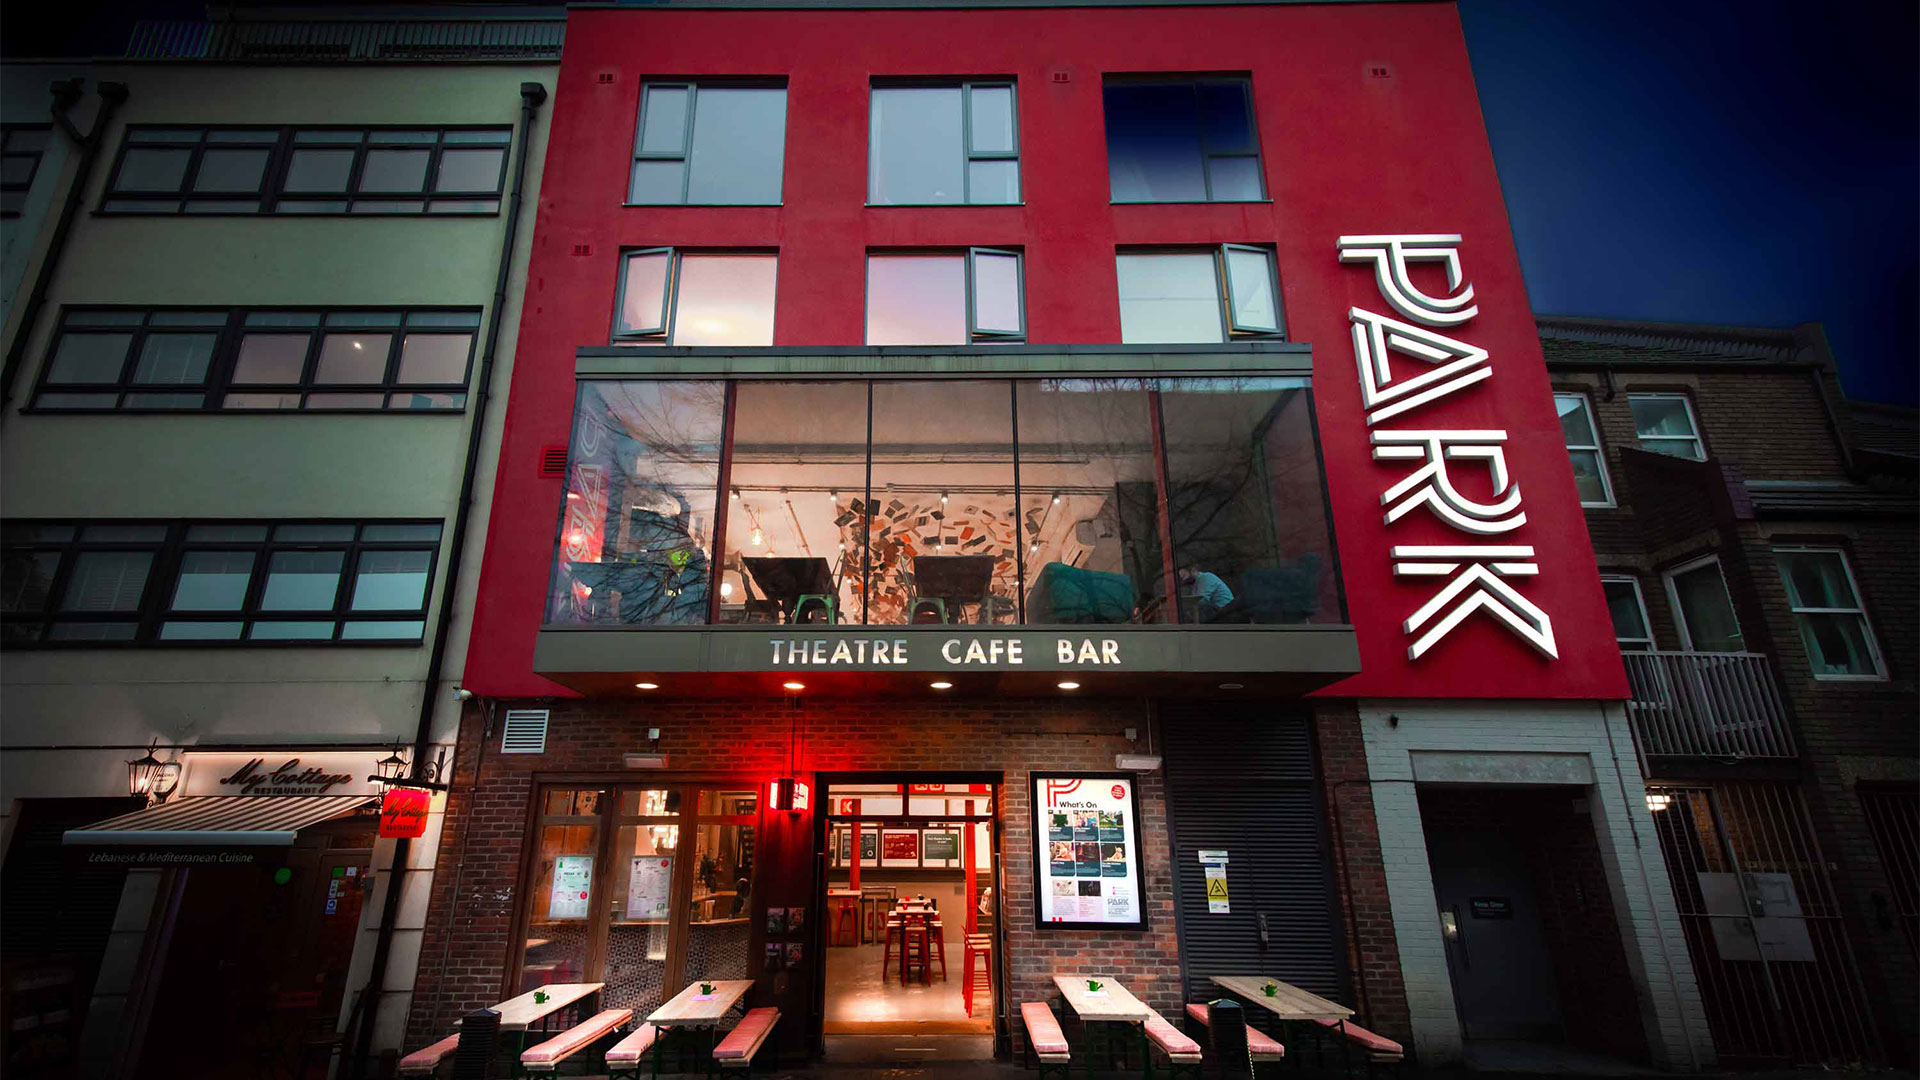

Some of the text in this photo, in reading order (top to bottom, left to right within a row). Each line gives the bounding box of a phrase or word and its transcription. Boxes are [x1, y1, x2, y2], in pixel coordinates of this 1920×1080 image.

[1337, 233, 1559, 660] PARK
[770, 638, 1121, 665] THEATRE CAFE BAR
[220, 758, 352, 794] My Cottage
[1059, 801, 1098, 809] What's On
[88, 852, 253, 863] Lebanese & Mediterranean Cuisine
